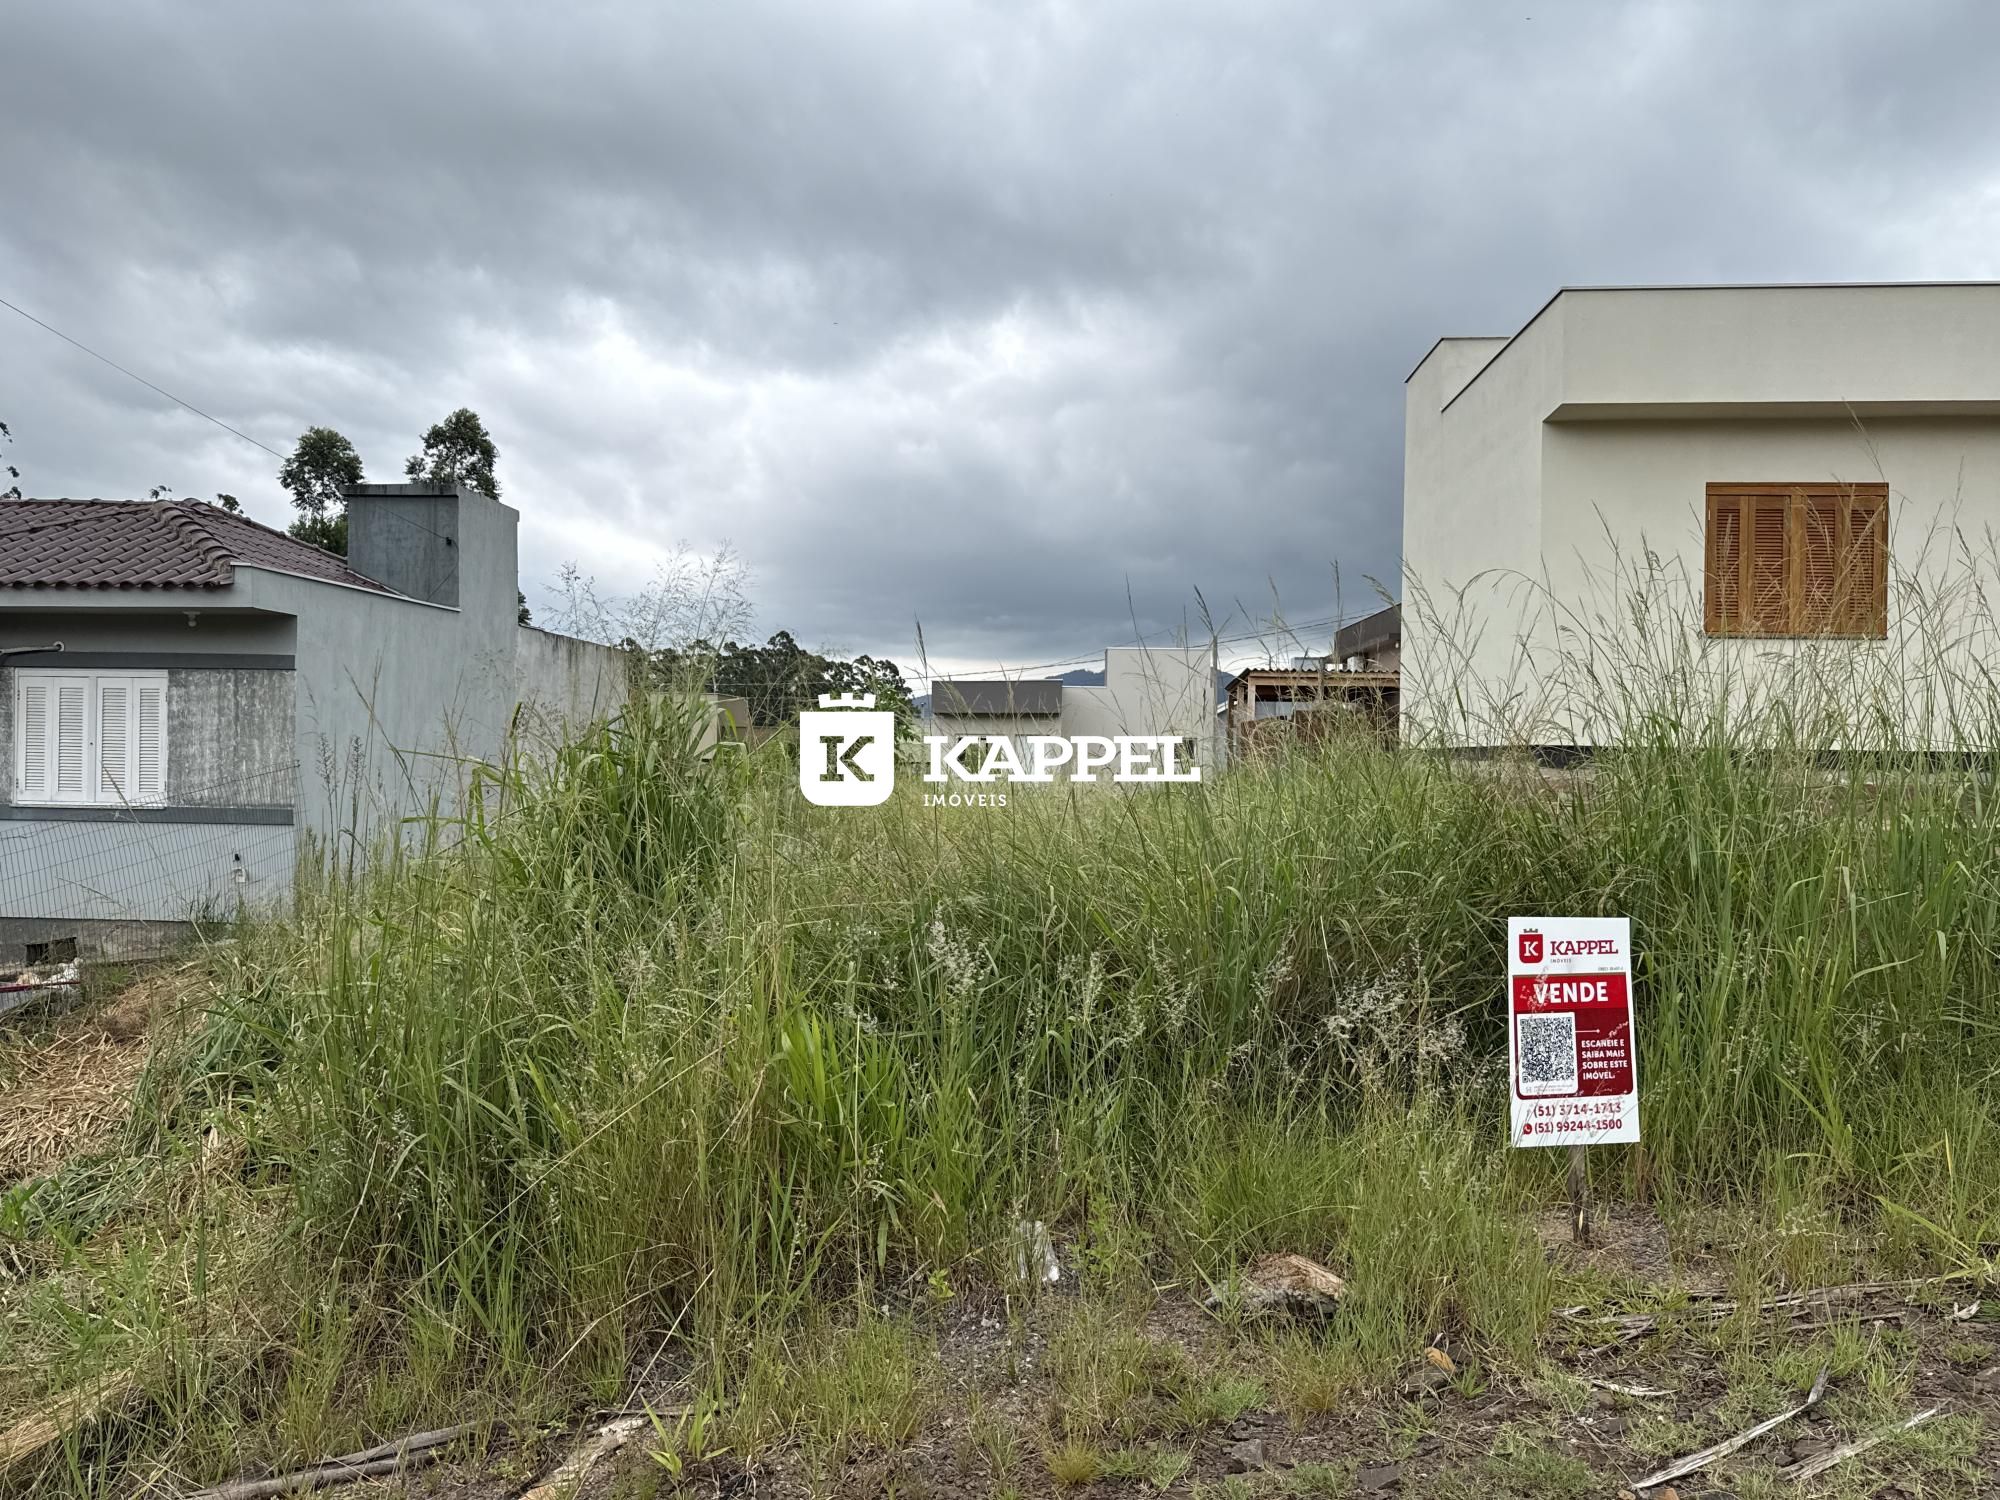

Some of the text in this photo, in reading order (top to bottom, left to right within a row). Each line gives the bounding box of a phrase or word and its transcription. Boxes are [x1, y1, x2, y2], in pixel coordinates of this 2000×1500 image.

[1523, 941, 1539, 957] K
[1550, 940, 1619, 955] KAPPEL
[1533, 981, 1609, 1004] VENDE
[1581, 1039, 1625, 1048] ESCANEIE E
[1581, 1049, 1625, 1059] SAIBA MAIS
[1582, 1060, 1628, 1070] SOBRE ESTE
[1583, 1070, 1616, 1081] IMÓVEL.
[1533, 1103, 1621, 1118] (51) 3714-1713
[1534, 1122, 1554, 1134] (51)
